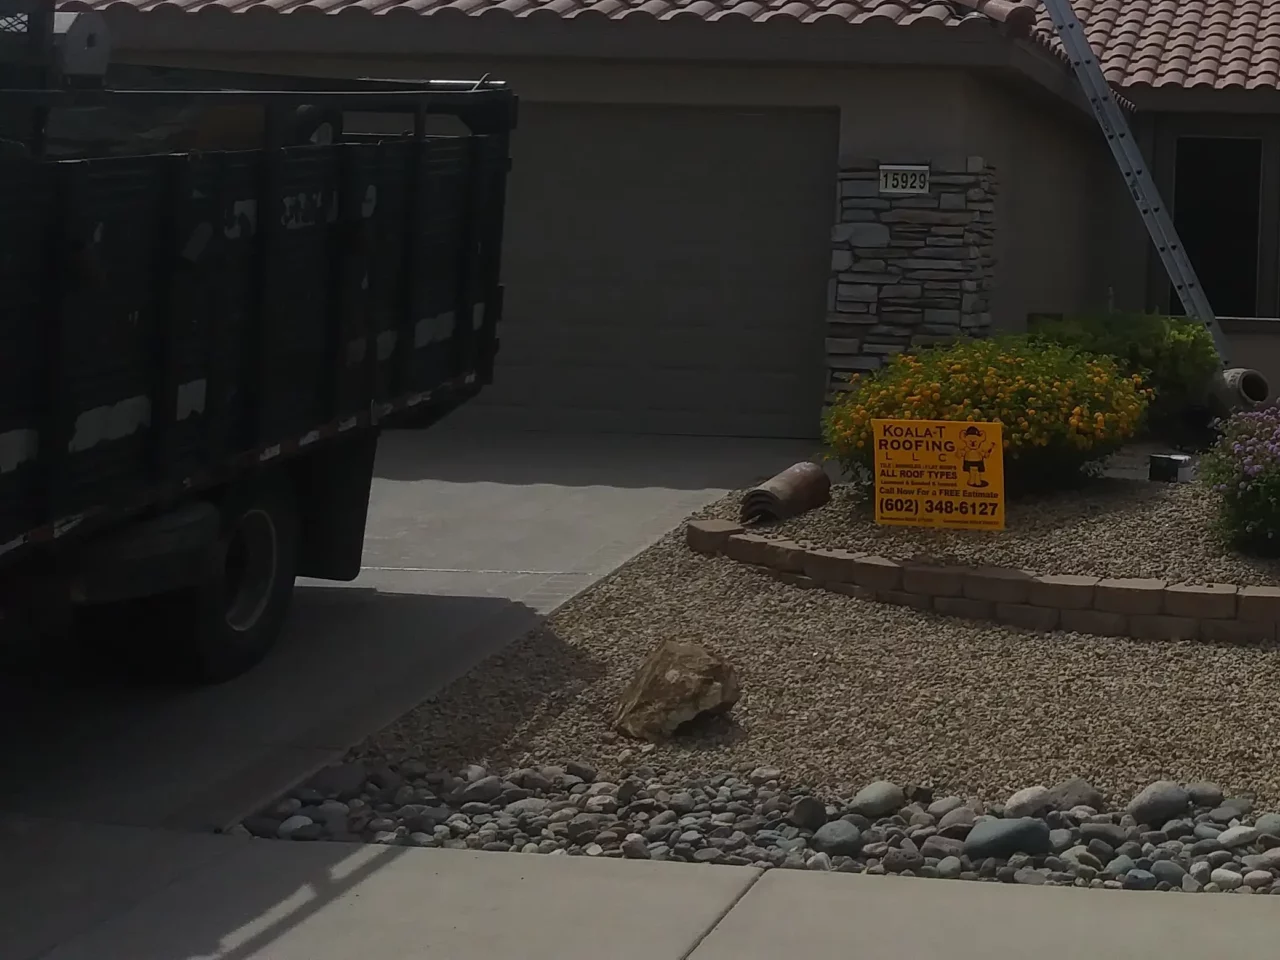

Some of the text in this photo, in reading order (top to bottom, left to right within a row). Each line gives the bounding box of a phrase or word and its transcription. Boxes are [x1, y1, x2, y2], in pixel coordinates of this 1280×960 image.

[883, 172, 926, 189] 15929
[883, 424, 946, 438] KOALA-T
[879, 439, 955, 452] ROOFING
[880, 469, 957, 480] ALL ROOF TYPES
[917, 488, 930, 496] For
[963, 490, 999, 499] Estimate
[879, 498, 999, 516] (602) 348-6127
